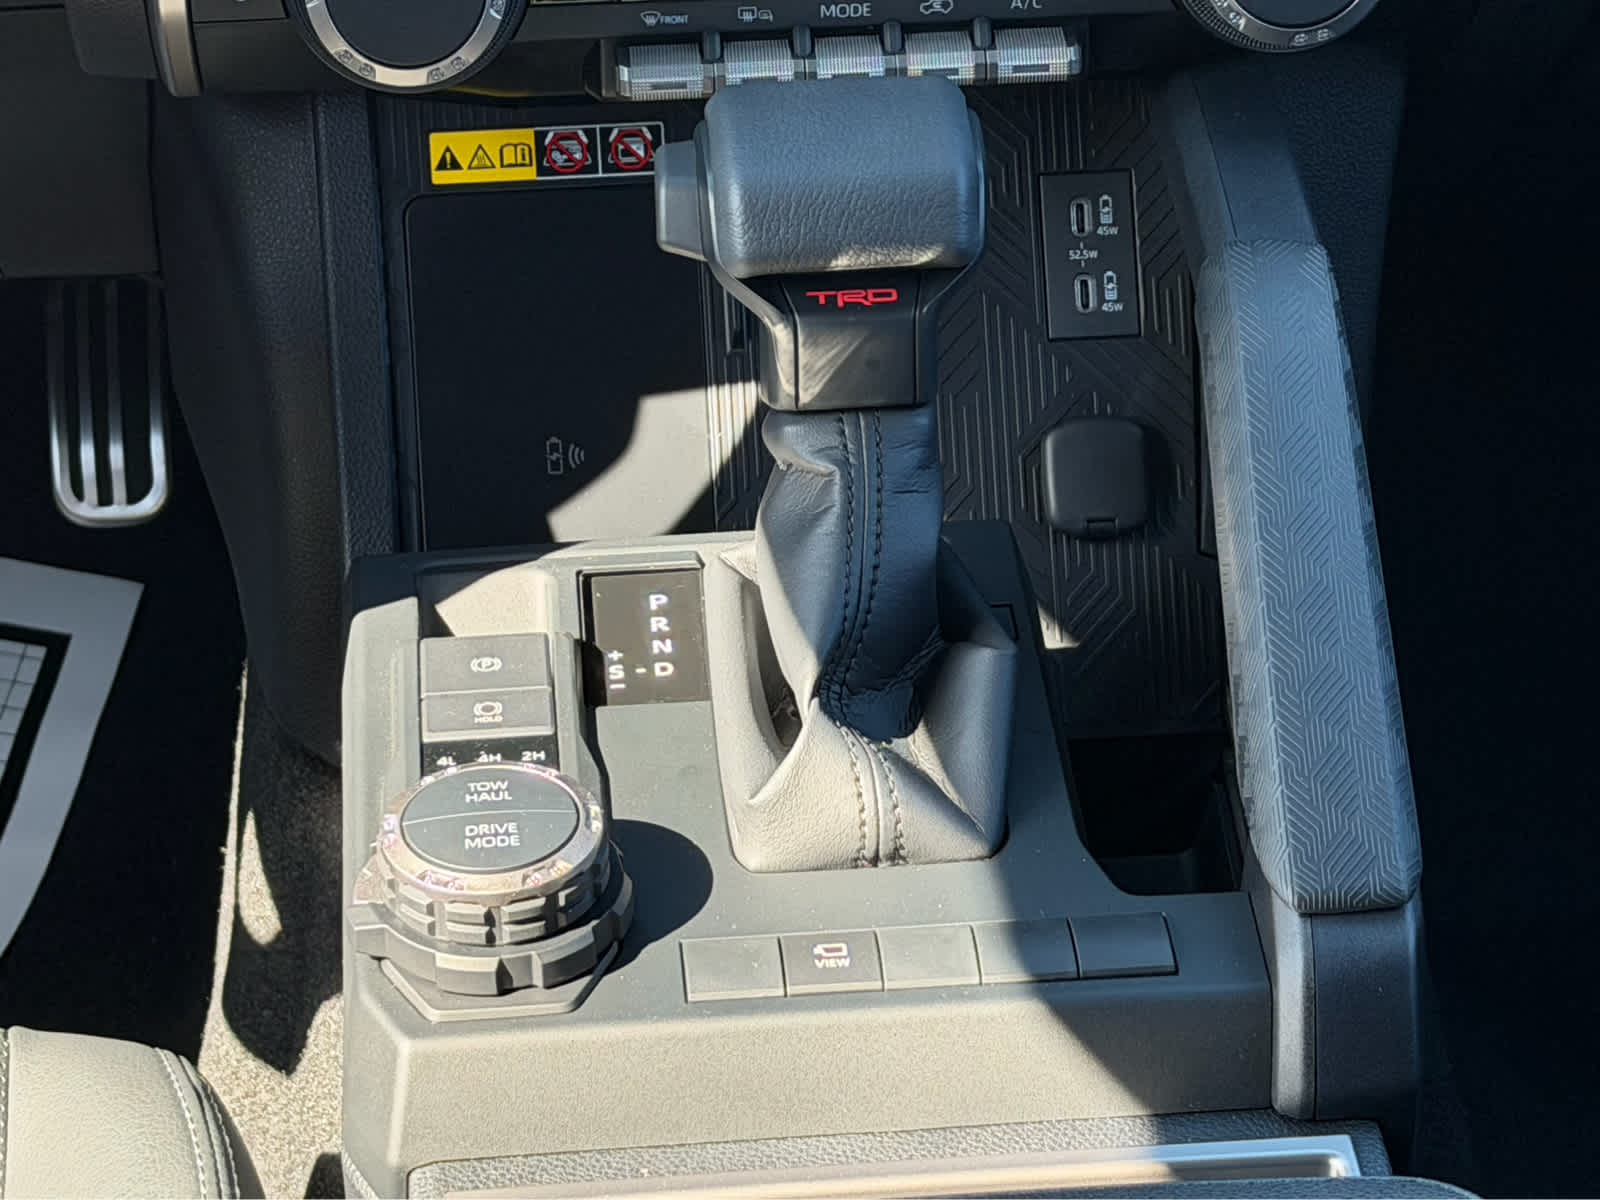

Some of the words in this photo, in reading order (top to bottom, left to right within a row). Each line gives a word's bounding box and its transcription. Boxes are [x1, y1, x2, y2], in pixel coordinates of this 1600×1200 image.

[820, 2, 872, 19] MODE
[660, 15, 689, 25] FRONT
[1096, 225, 1119, 236] 45W
[1068, 249, 1099, 261] 52.5W
[805, 288, 899, 308] TRD
[1101, 302, 1124, 312] 45W
[648, 593, 669, 611] P
[650, 616, 671, 633] R
[652, 638, 673, 655] N
[653, 661, 675, 677] D
[474, 715, 504, 724] HOLD
[436, 756, 457, 766] 4L
[478, 753, 502, 762] 4H
[521, 751, 546, 761] 2H
[467, 781, 509, 793] TOW
[465, 791, 513, 803] HAUL
[464, 822, 519, 837] DRIVE
[464, 834, 521, 850] MODE
[814, 958, 850, 969] VIEW
